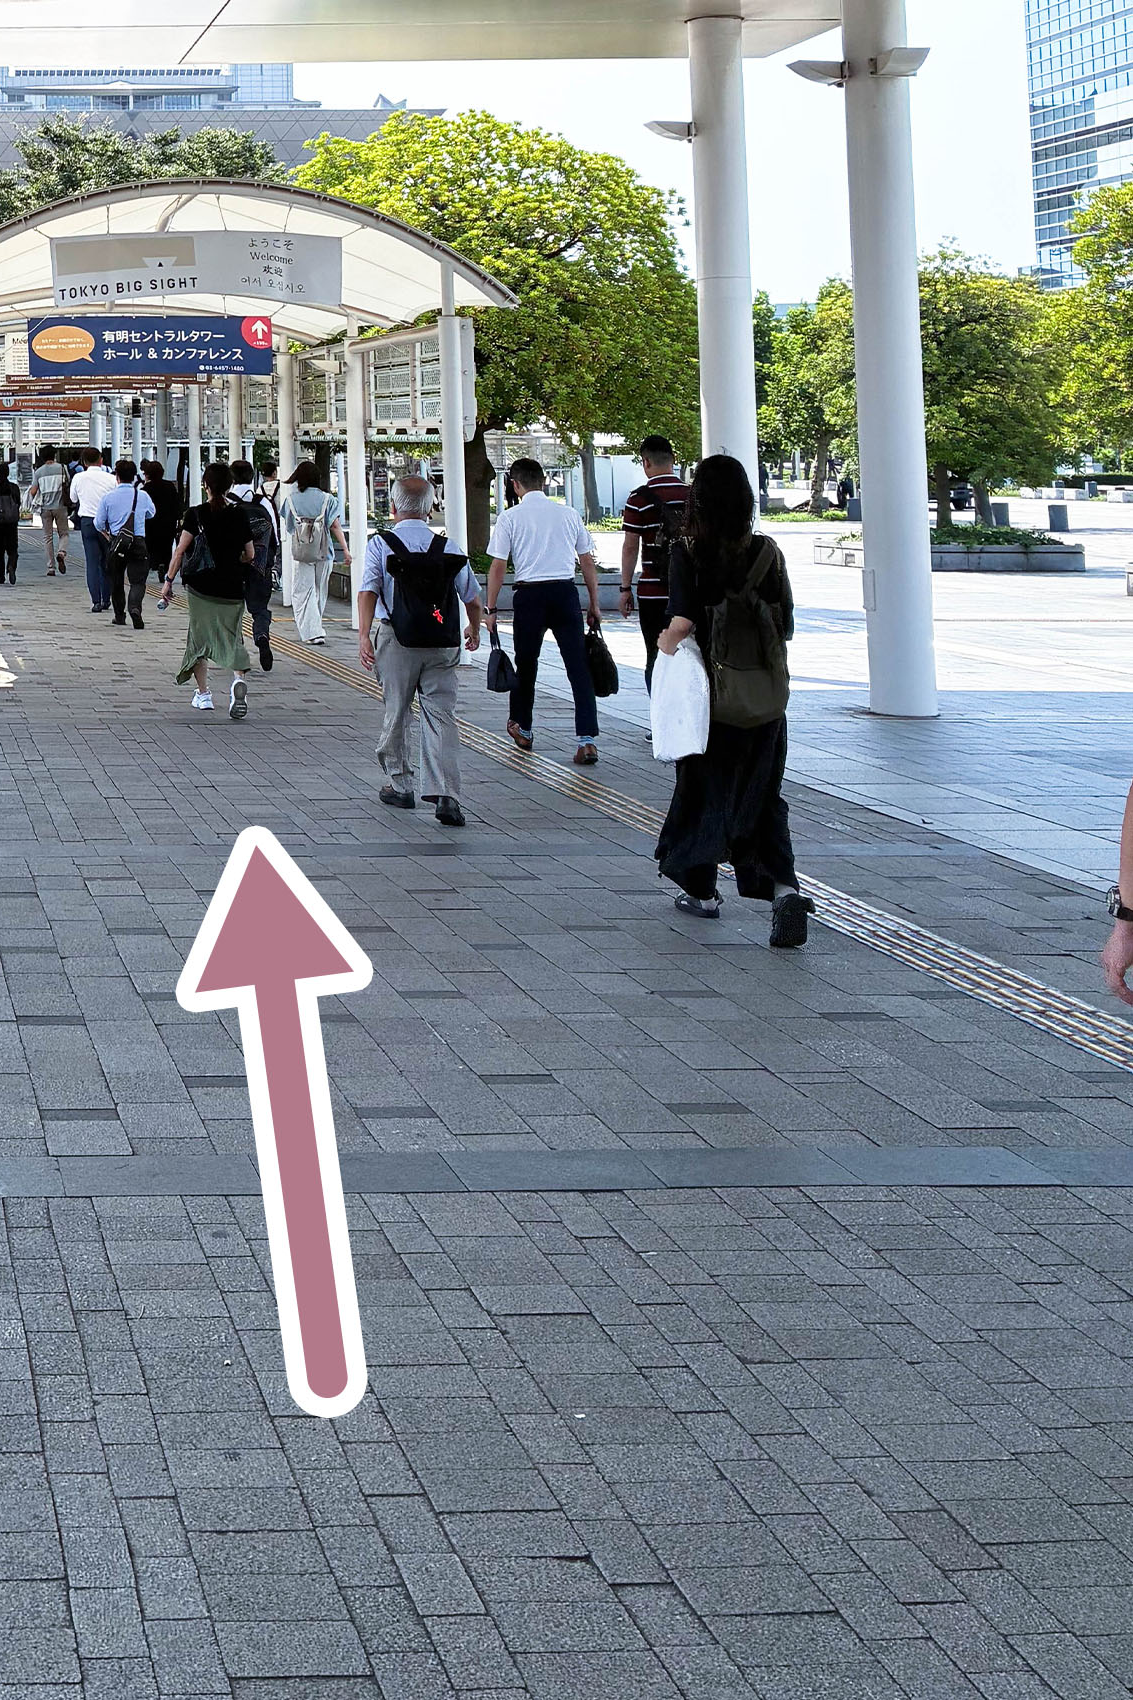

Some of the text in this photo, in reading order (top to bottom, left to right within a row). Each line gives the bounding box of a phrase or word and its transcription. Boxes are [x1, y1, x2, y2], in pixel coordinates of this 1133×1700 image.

[248, 237, 294, 251] ようこそ
[249, 251, 294, 265] Welcome
[262, 264, 283, 278] 欢迎
[59, 277, 198, 301] TOKYO BIG SIGHT
[240, 276, 262, 288] 어서
[102, 330, 225, 344] 有明セントラルタワー
[103, 347, 244, 361] ホール & カンファレンス
